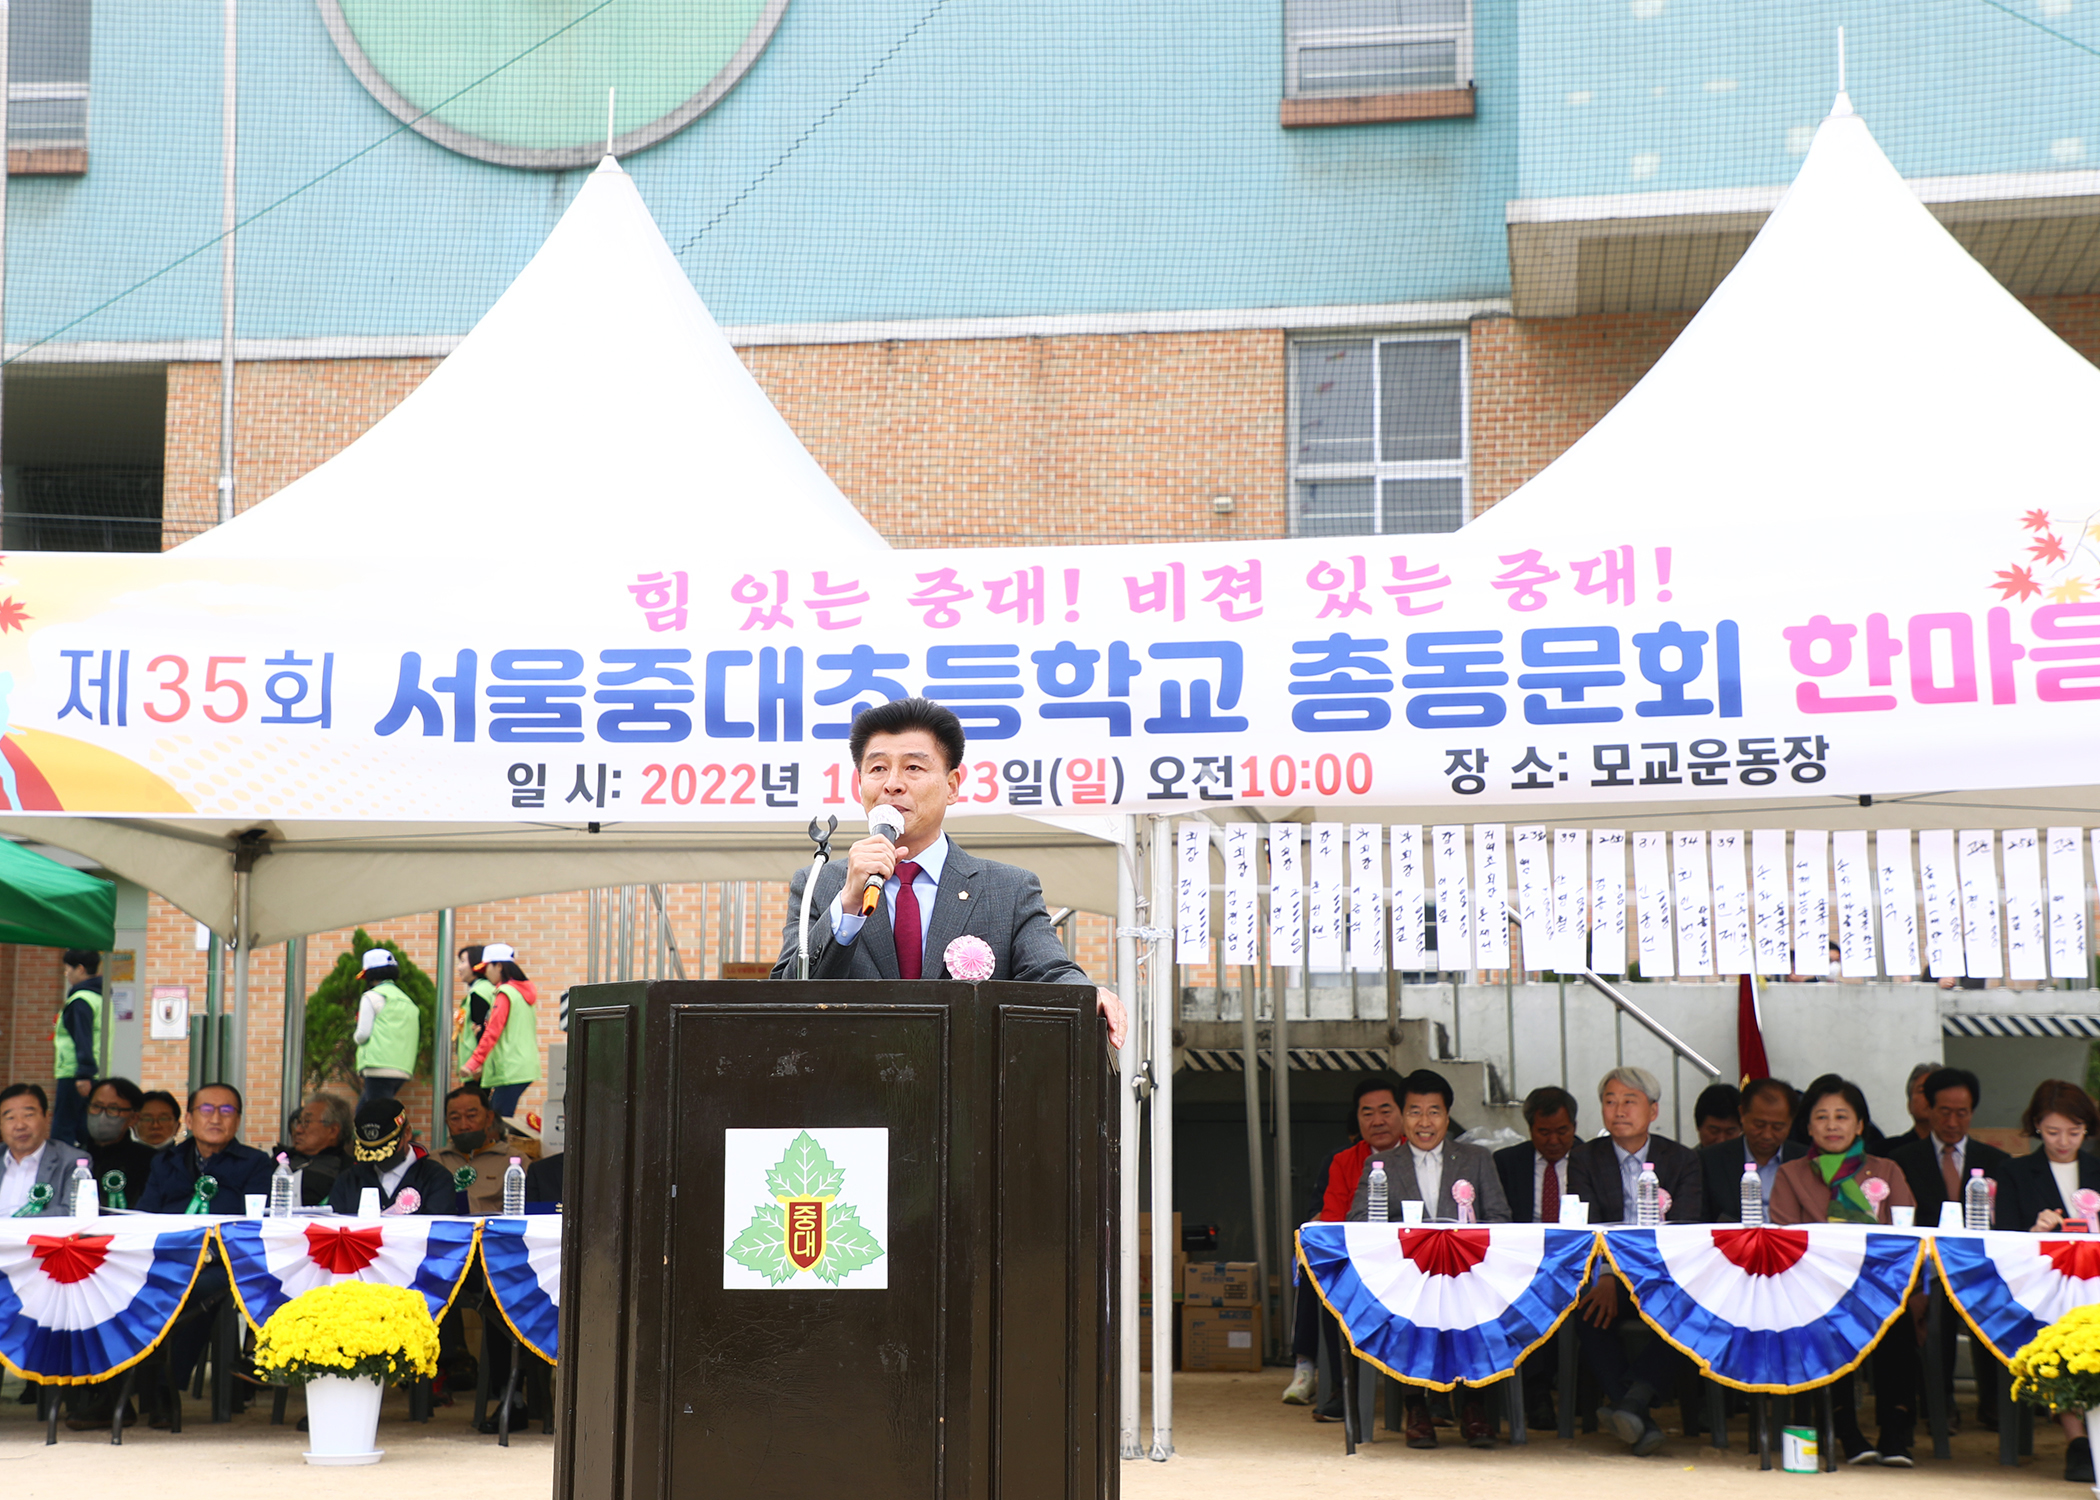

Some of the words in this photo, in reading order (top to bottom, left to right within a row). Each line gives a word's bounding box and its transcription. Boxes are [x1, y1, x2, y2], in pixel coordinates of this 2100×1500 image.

[628, 570, 689, 633] 힘
[730, 569, 871, 631] 있는
[907, 565, 1081, 629] 중대!
[1306, 554, 1453, 618] 있는
[1491, 545, 1675, 612] 중대!
[57, 649, 335, 729] 제35회
[374, 640, 1249, 743] 서울중대초등학교
[1288, 619, 1744, 733] 총동문회
[507, 763, 548, 808] 일
[565, 762, 623, 808] 시:
[641, 762, 801, 808] 2022년
[1147, 751, 1374, 804] 오전10:00
[1444, 749, 1490, 796] 장
[1511, 746, 1570, 791] 소:
[1591, 735, 1831, 789] 모교운동장
[793, 1205, 818, 1258] 중대
